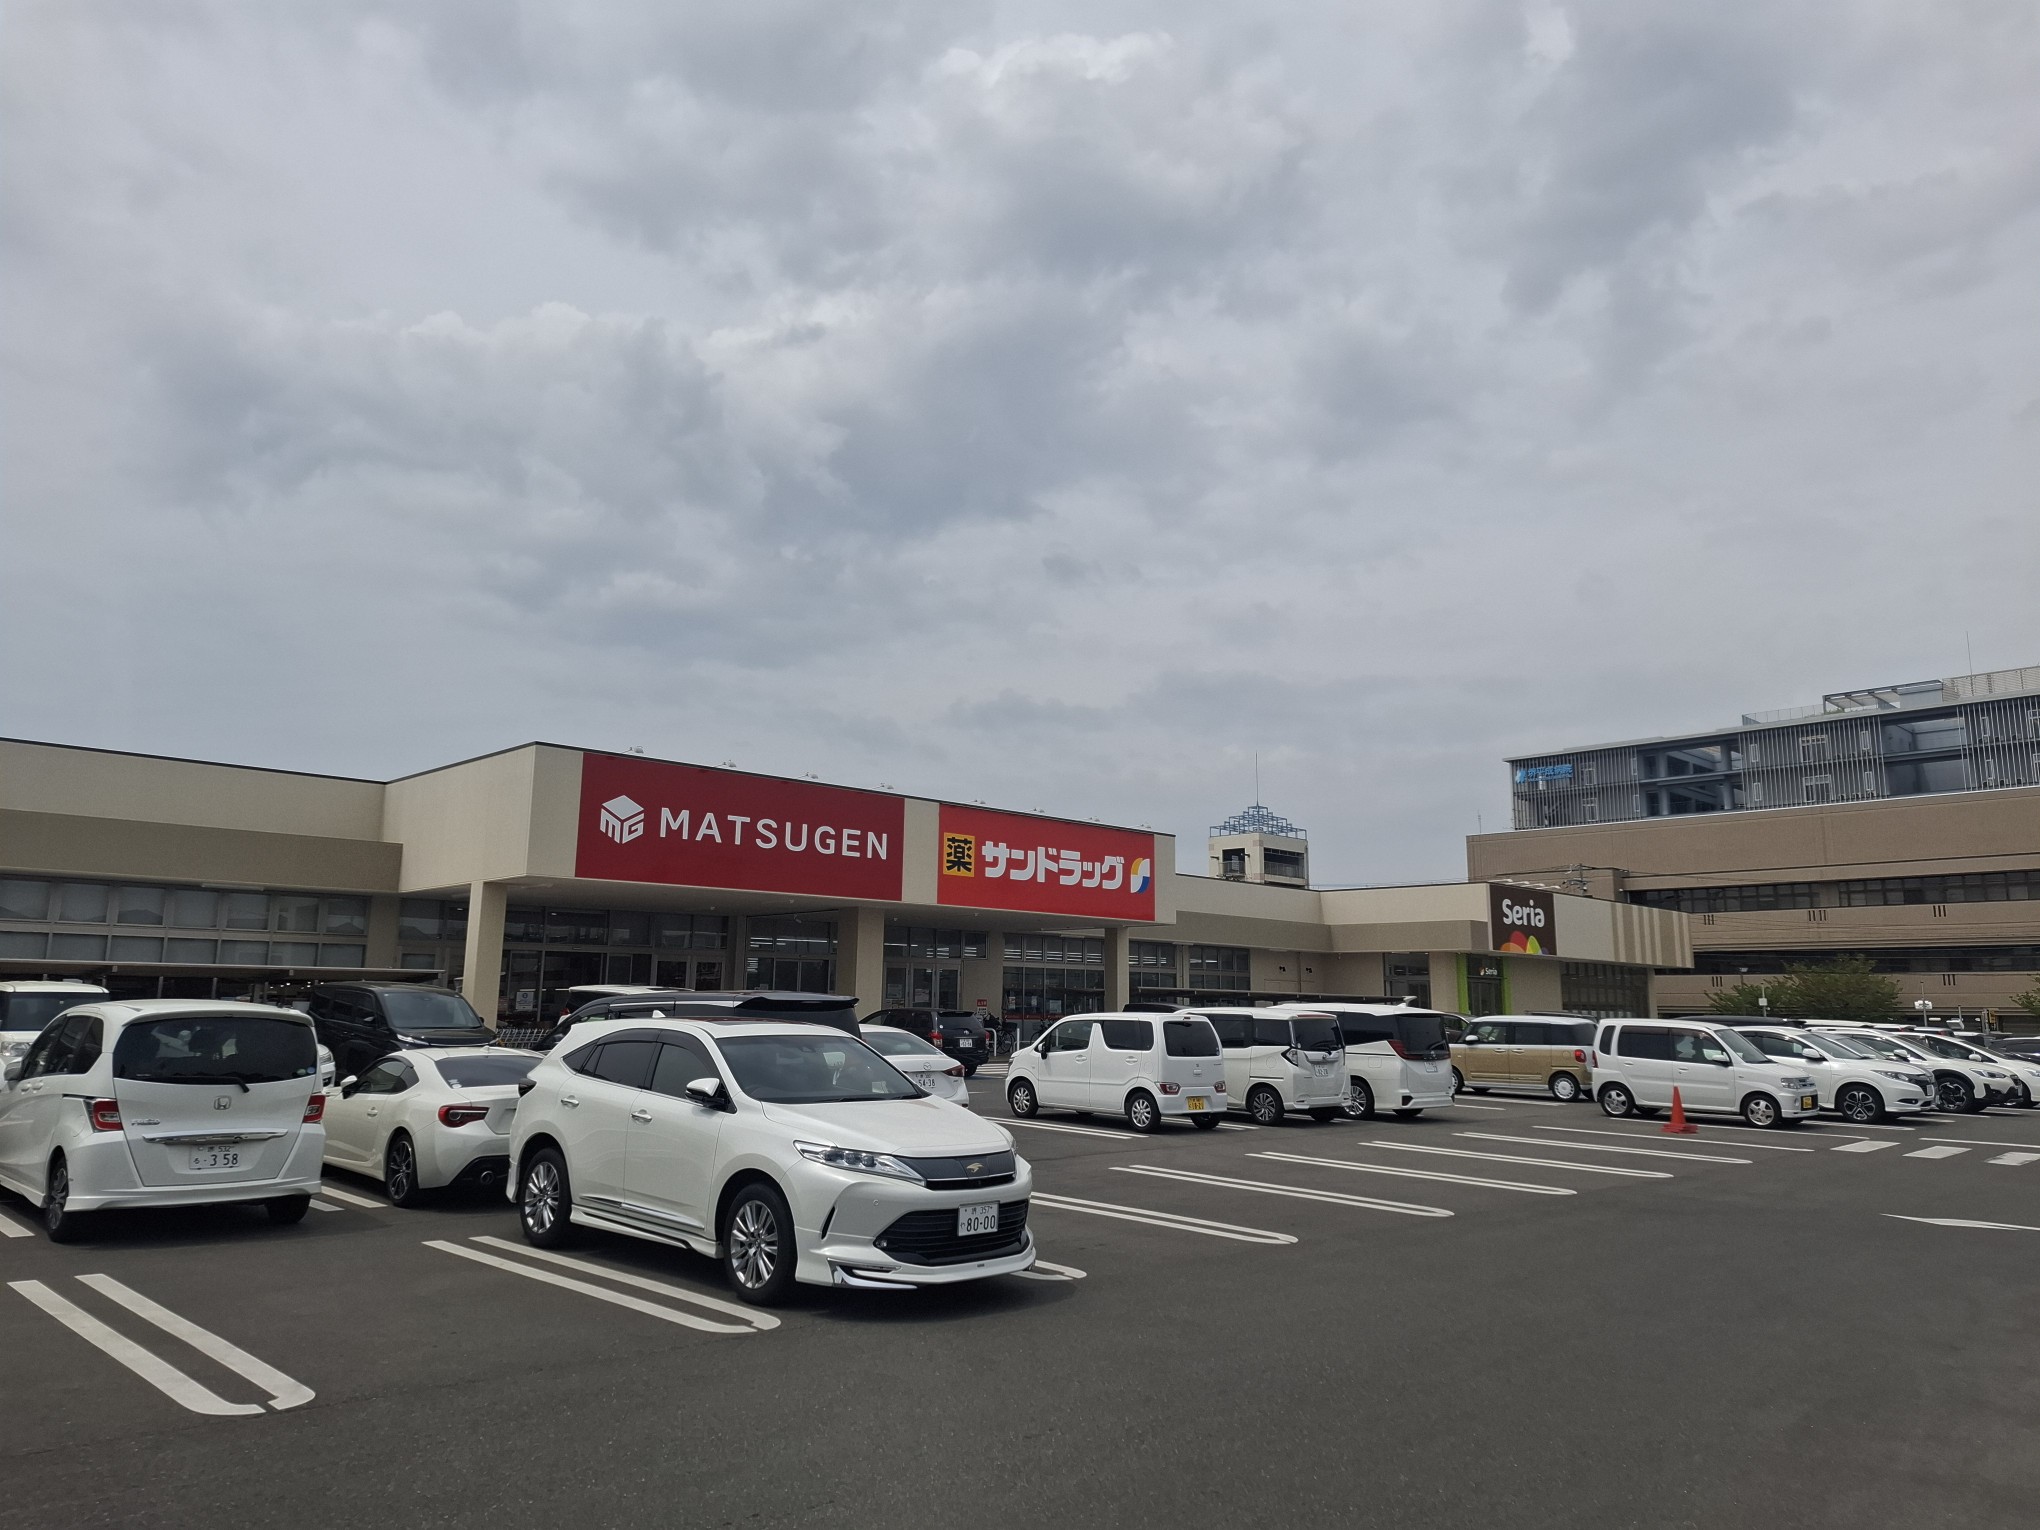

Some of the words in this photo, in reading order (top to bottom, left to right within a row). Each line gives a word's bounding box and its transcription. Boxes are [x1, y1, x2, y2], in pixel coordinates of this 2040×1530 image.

[659, 807, 887, 860] MATSUGEN
[946, 836, 973, 873] 薬
[981, 841, 1125, 889] サンドラッグ
[1502, 898, 1545, 928] Seria
[1485, 967, 1498, 976] Seria
[966, 1215, 996, 1232] 80-00
